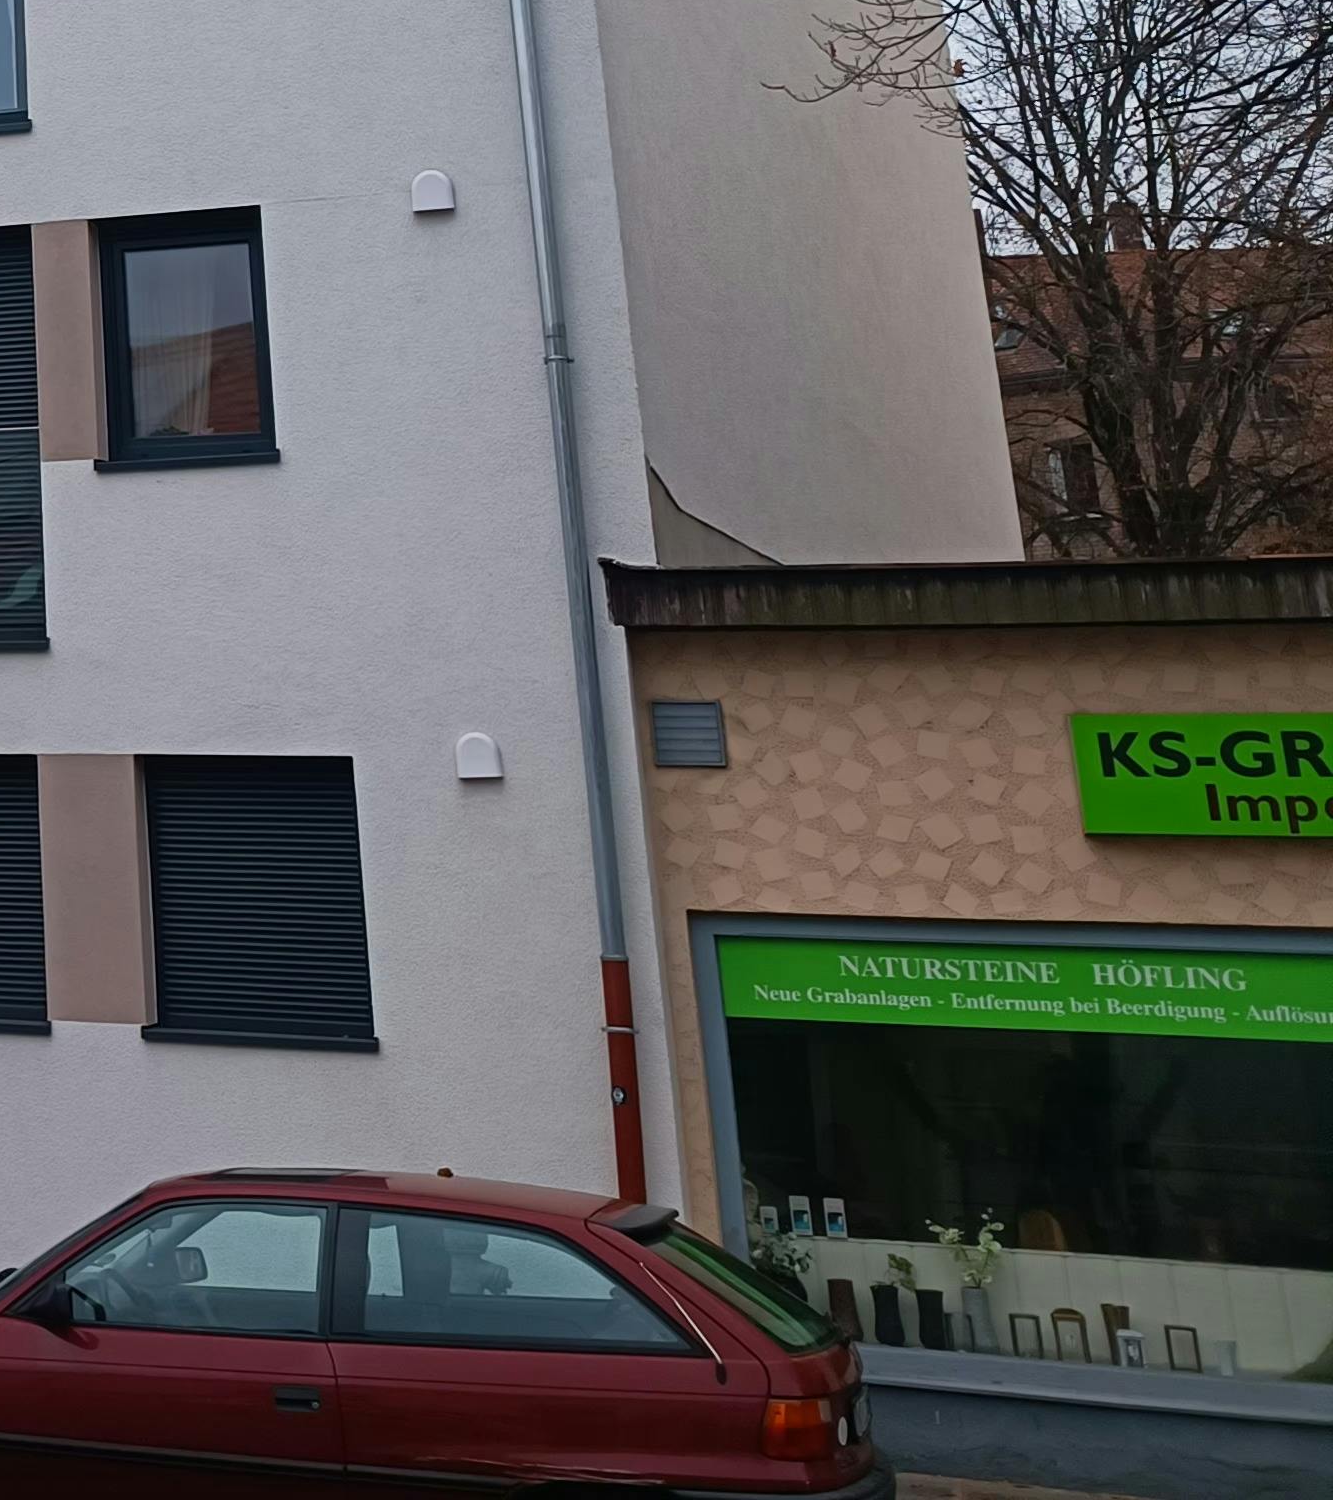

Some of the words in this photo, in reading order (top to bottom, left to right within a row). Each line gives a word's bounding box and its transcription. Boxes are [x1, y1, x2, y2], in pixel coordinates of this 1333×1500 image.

[1205, 784, 1333, 834] Imp
[839, 955, 1060, 984] NATURSTEINE
[1092, 959, 1247, 991] HÖFLING
[754, 985, 801, 1002] Neue
[807, 987, 932, 1011] Grabanlagen
[950, 993, 1065, 1017] Entfernung
[1070, 998, 1100, 1014] bei
[1106, 999, 1226, 1023] Beerdigung
